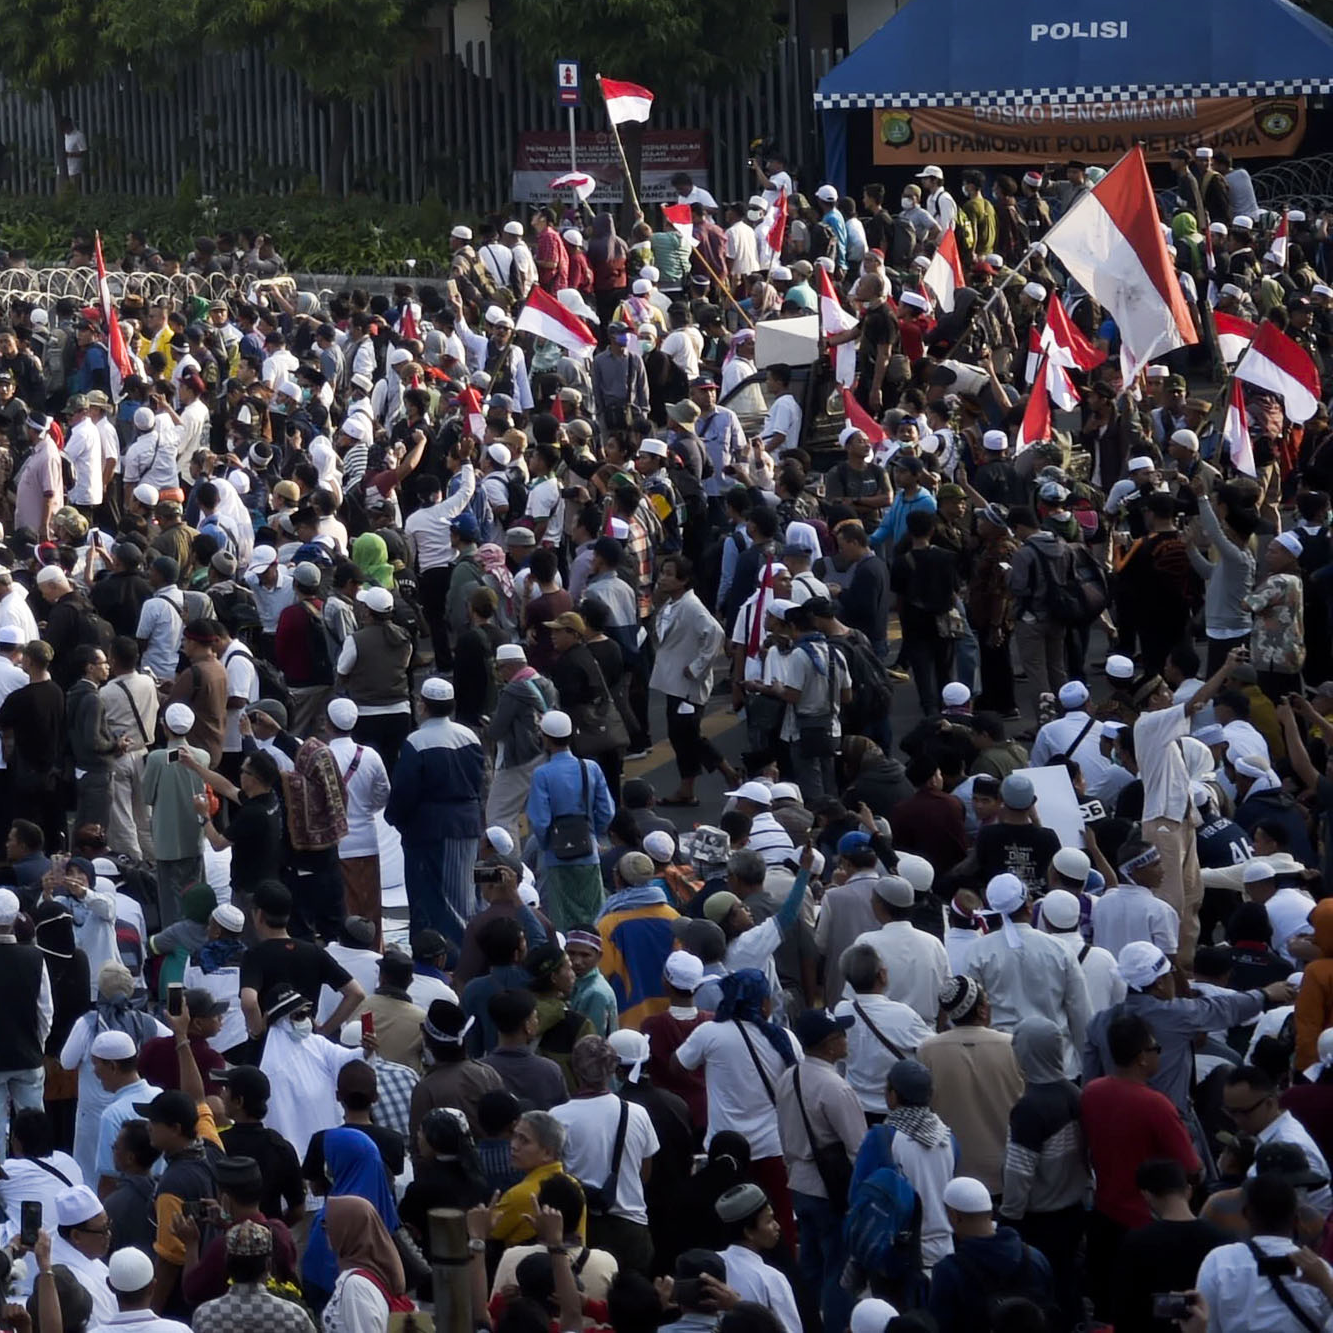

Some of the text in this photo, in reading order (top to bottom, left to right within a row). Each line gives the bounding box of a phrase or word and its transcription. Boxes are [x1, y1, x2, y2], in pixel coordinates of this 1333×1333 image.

[1031, 21, 1128, 41] POLISI
[974, 98, 1197, 125] POSKO PENGAMANAN
[1057, 134, 1127, 154] POLDA
[1208, 126, 1261, 148] JAYA
